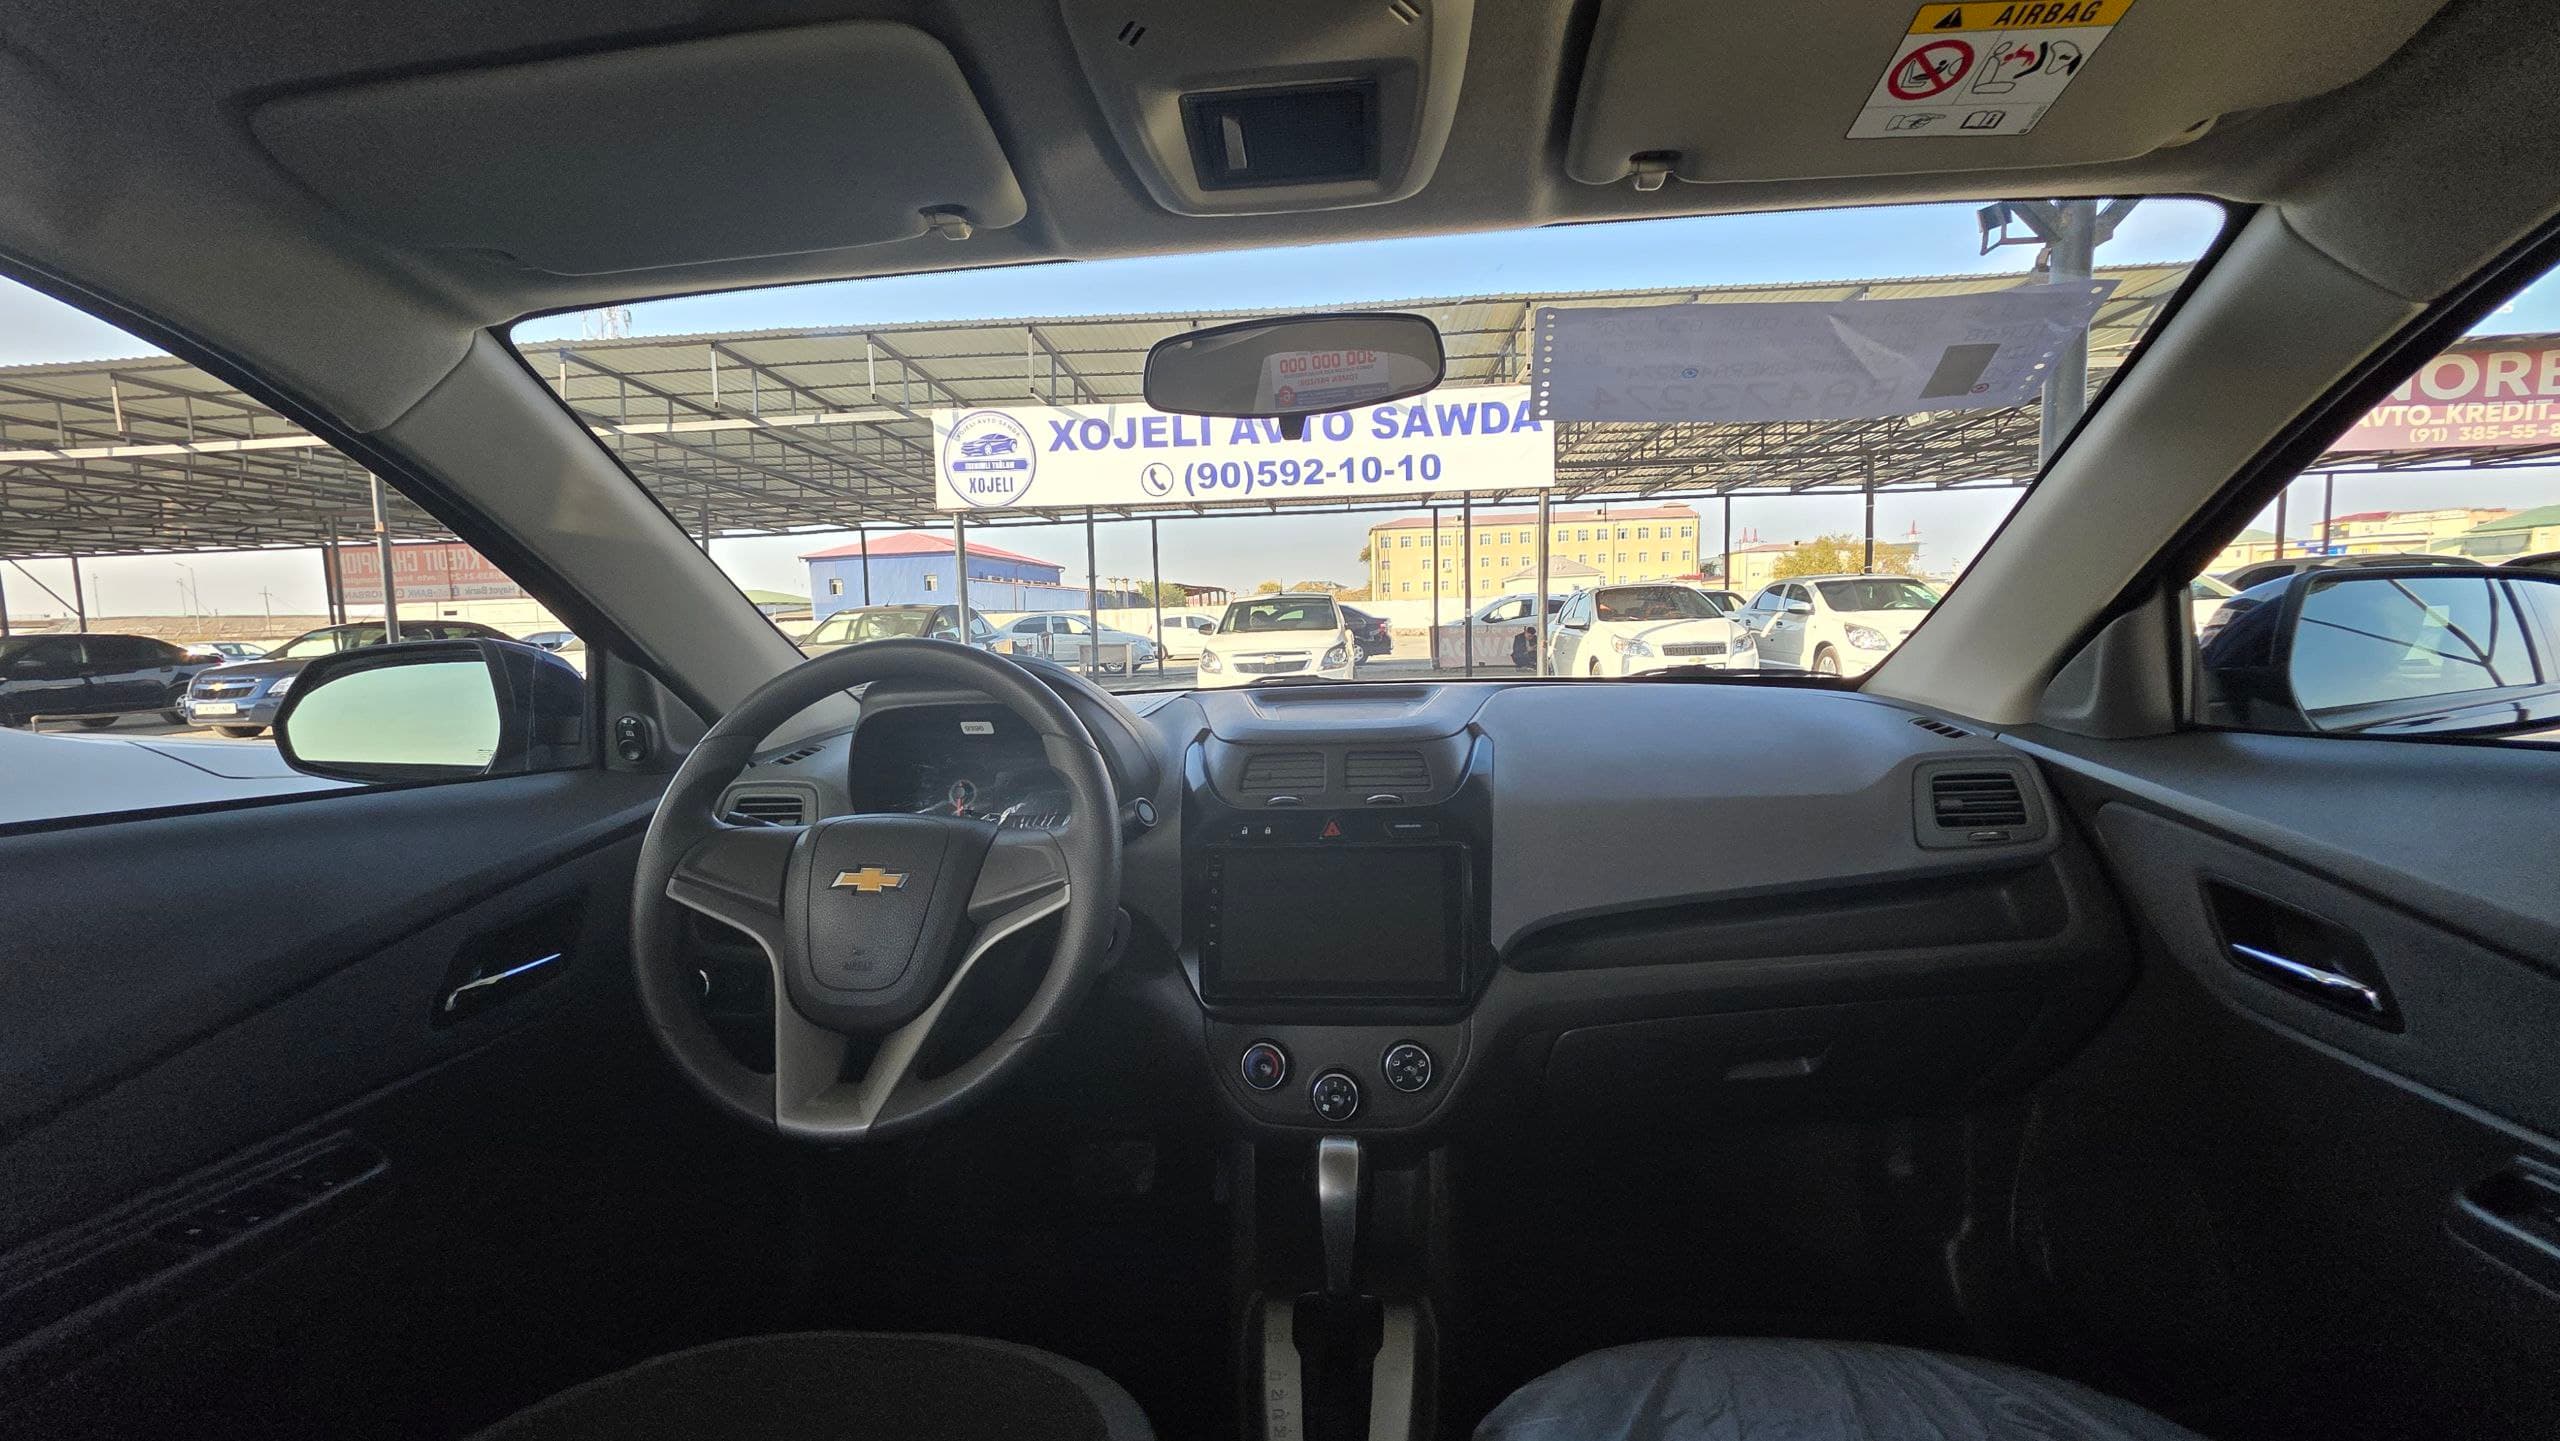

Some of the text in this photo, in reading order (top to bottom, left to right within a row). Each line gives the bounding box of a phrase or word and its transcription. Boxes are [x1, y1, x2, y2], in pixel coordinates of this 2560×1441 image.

[1993, 0, 2105, 26] AIRBAG
[1049, 415, 1211, 453] XOJELI
[1371, 399, 1544, 439] SAWDA
[2409, 427, 2448, 443] (91)
[969, 477, 1014, 494] XOJELI
[1184, 453, 1442, 496] (90)592-10-10
